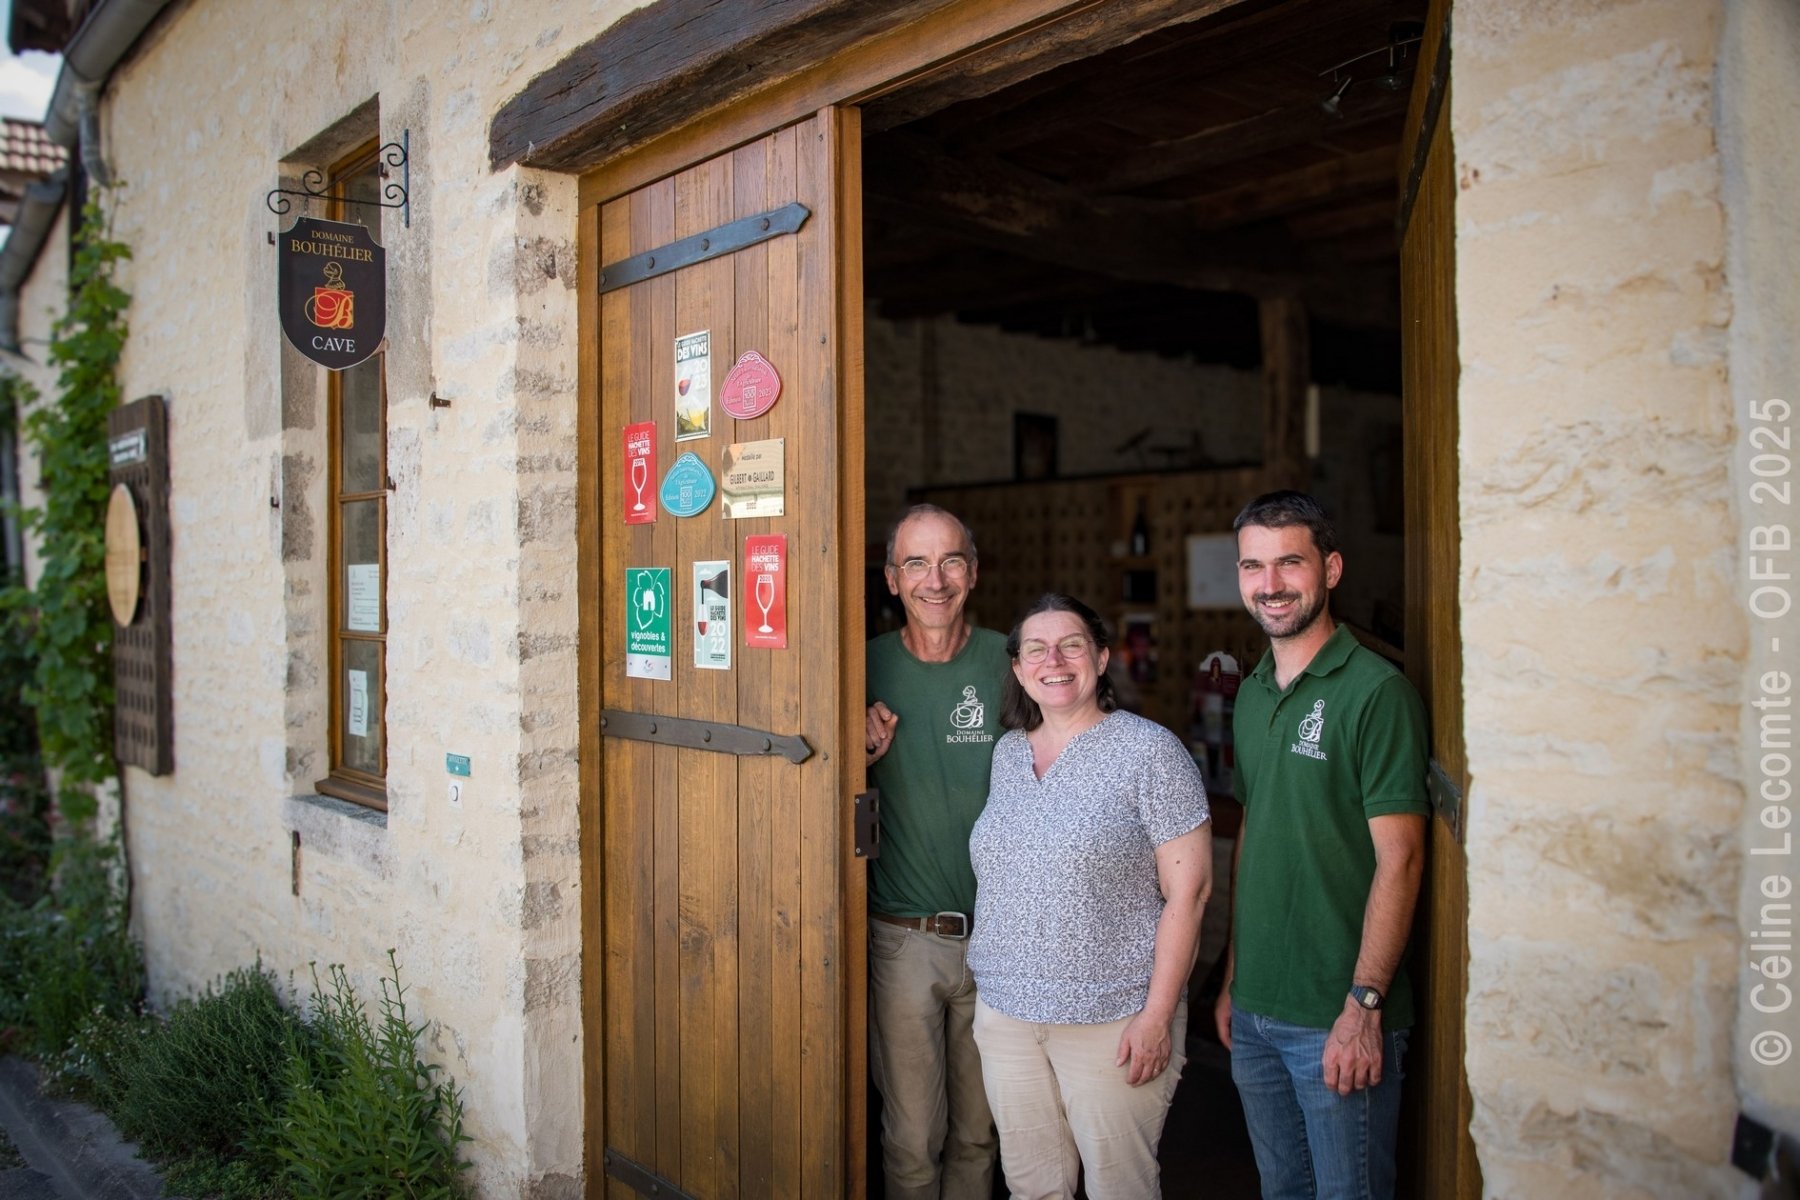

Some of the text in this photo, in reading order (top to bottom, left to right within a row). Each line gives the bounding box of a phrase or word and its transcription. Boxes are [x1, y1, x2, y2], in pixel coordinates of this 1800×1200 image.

[312, 231, 354, 243] DOMAINE
[292, 239, 373, 262] BOUHÉLIER
[312, 336, 355, 353] CAVE
[678, 342, 707, 360] DES VINS
[634, 431, 650, 441] GUIDE
[628, 440, 650, 448] HACHETTE
[638, 447, 650, 456] VINS
[730, 473, 747, 484] GILBERT
[753, 470, 774, 482] GAILLARD
[752, 545, 779, 554] LE GUIDE
[752, 563, 779, 572] DES VINS
[710, 622, 726, 636] 20
[631, 630, 666, 641] vignobles &
[631, 642, 666, 653] découvertes
[711, 637, 725, 653] 22
[947, 734, 993, 743] BOUHÉLIER
[1299, 740, 1319, 750] DOMAINE
[1291, 744, 1327, 760] BOUHÉLIER
